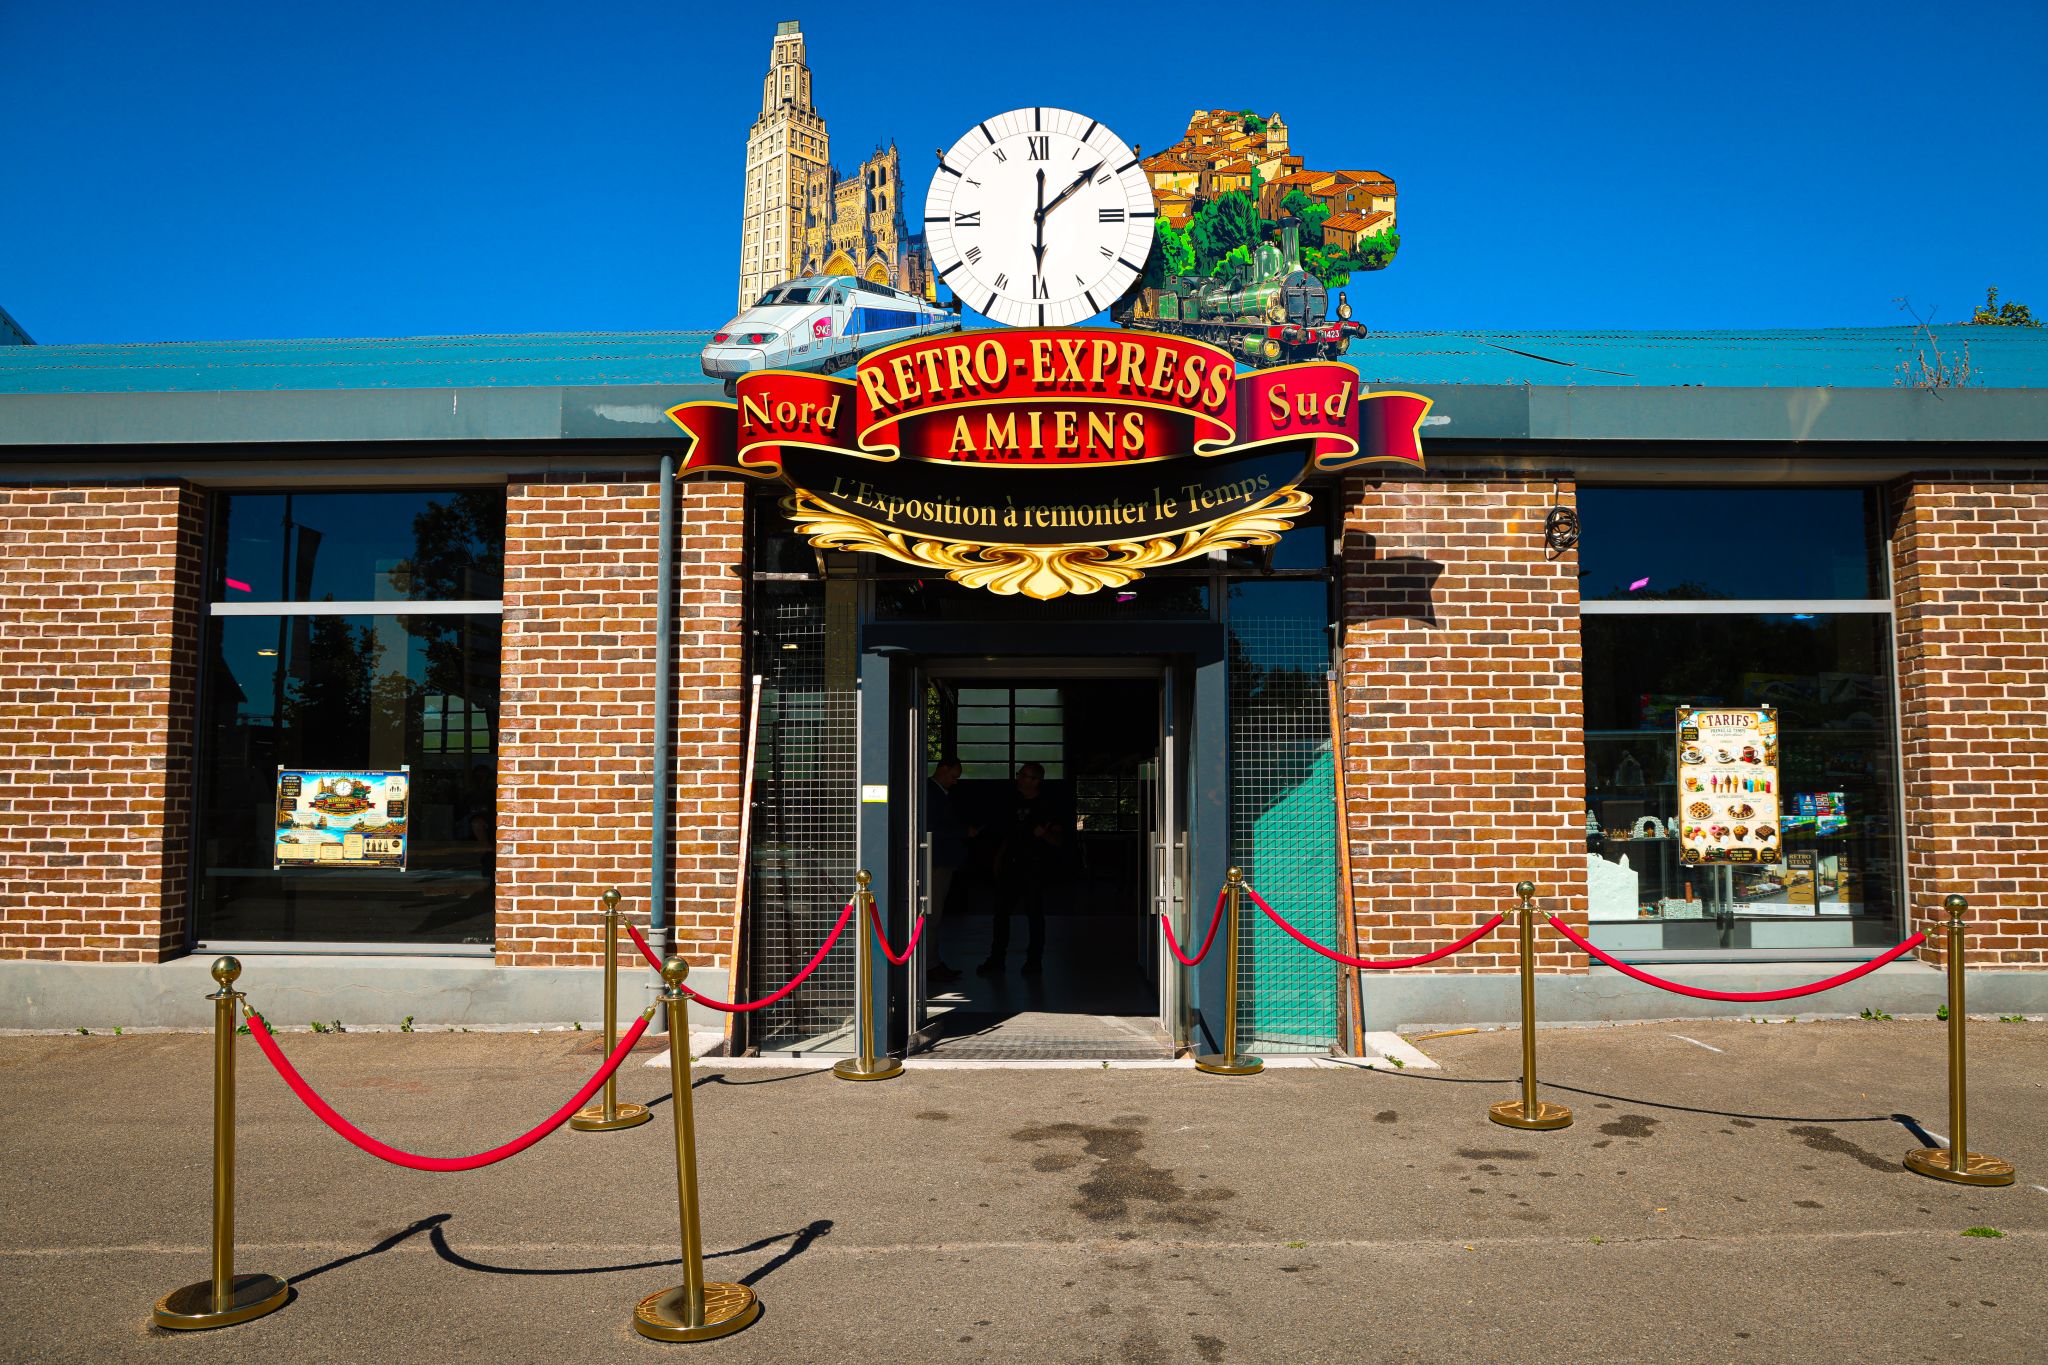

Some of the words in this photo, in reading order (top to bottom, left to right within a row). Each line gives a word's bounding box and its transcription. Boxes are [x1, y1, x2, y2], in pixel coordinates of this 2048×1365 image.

[992, 147, 1007, 164] XI
[1027, 135, 1049, 161] XII
[1071, 147, 1080, 161] I
[966, 176, 982, 189] X
[1097, 173, 1112, 185] II
[954, 210, 980, 227] IX
[1099, 208, 1124, 223] III
[965, 245, 982, 265] VIII
[993, 272, 1009, 291] VII
[1032, 274, 1050, 300] VI
[1075, 274, 1085, 288] V
[815, 324, 831, 336] SNCF
[857, 338, 1233, 413] RETRO-EXPRESS
[1267, 380, 1353, 421] Sud
[741, 391, 842, 431] Nord
[947, 410, 1146, 453] AMIENS
[829, 475, 998, 528] L'Exposition
[1003, 495, 1017, 528] à
[1022, 494, 1151, 528] remonter
[1153, 487, 1178, 521] le
[1181, 471, 1271, 514] Temps
[1706, 714, 1749, 727] TARIFS
